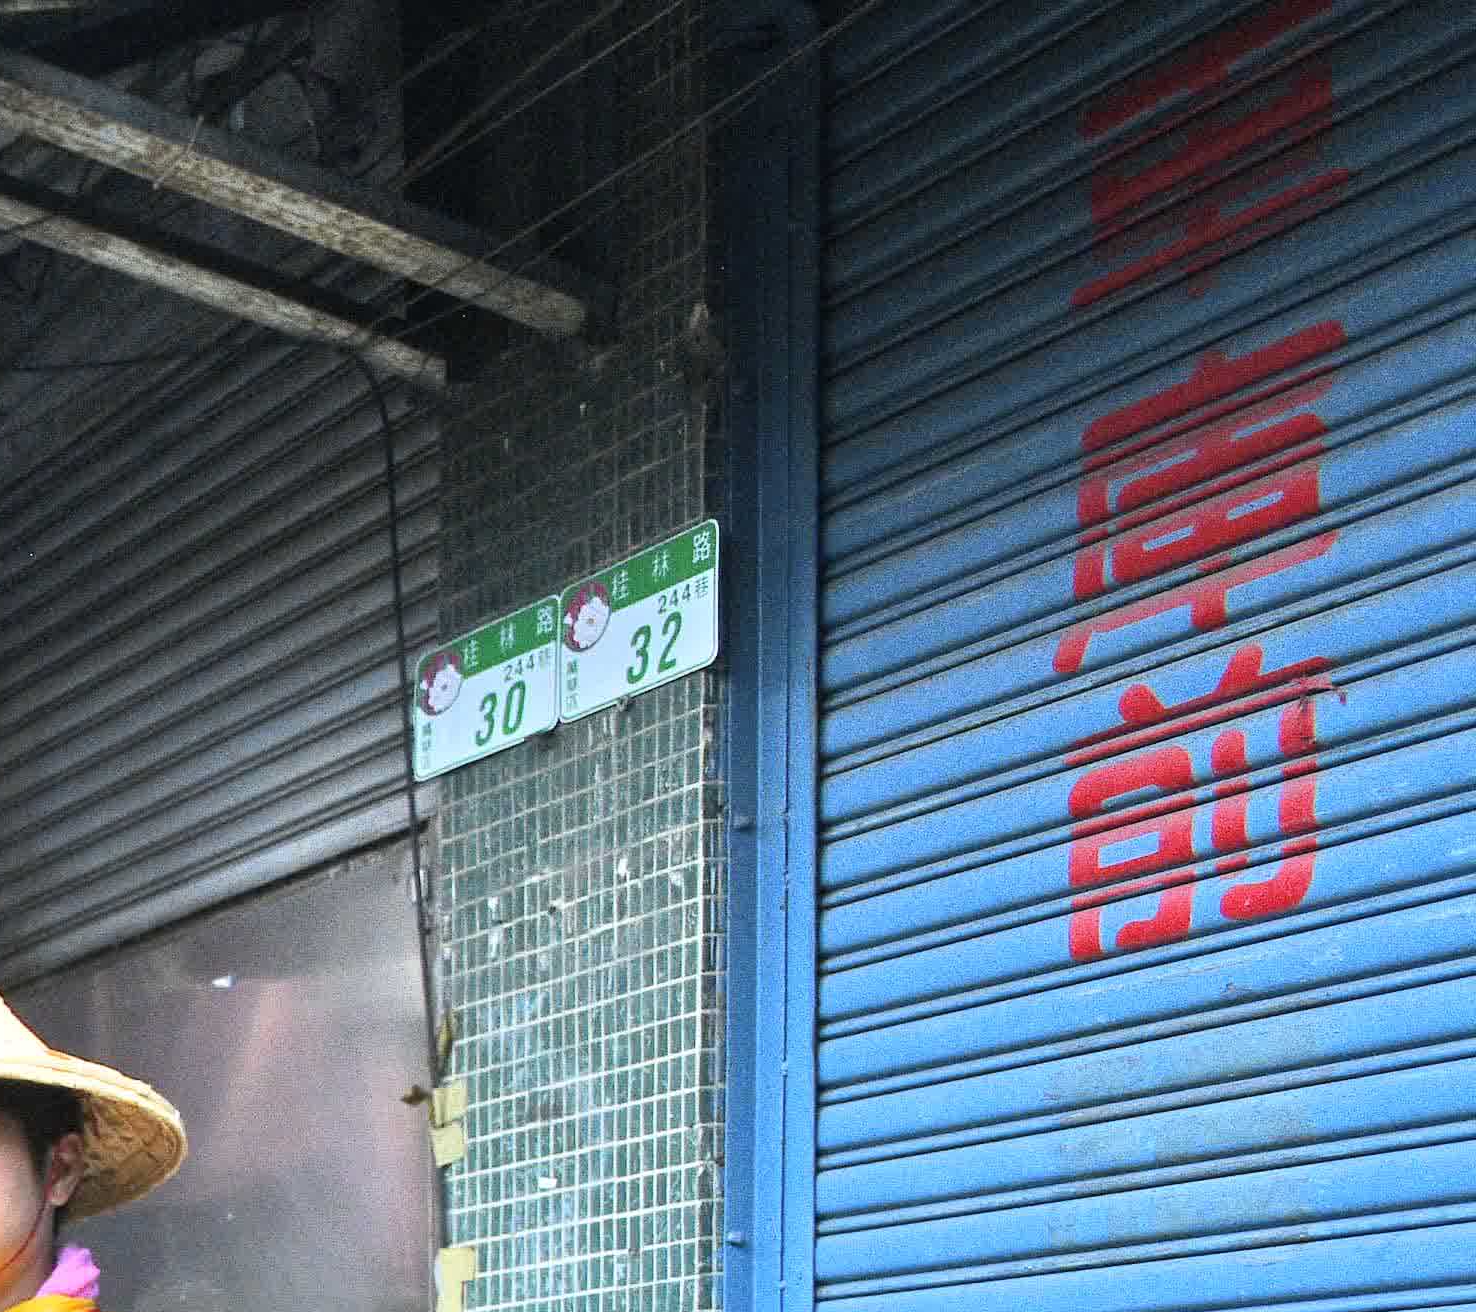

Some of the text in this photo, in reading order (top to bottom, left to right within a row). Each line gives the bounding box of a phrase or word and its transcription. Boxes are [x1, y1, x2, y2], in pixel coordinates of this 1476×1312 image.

[610, 530, 712, 600] 桂林路
[463, 604, 555, 670] 桂林路
[625, 609, 684, 686] 32
[474, 679, 528, 748] 30
